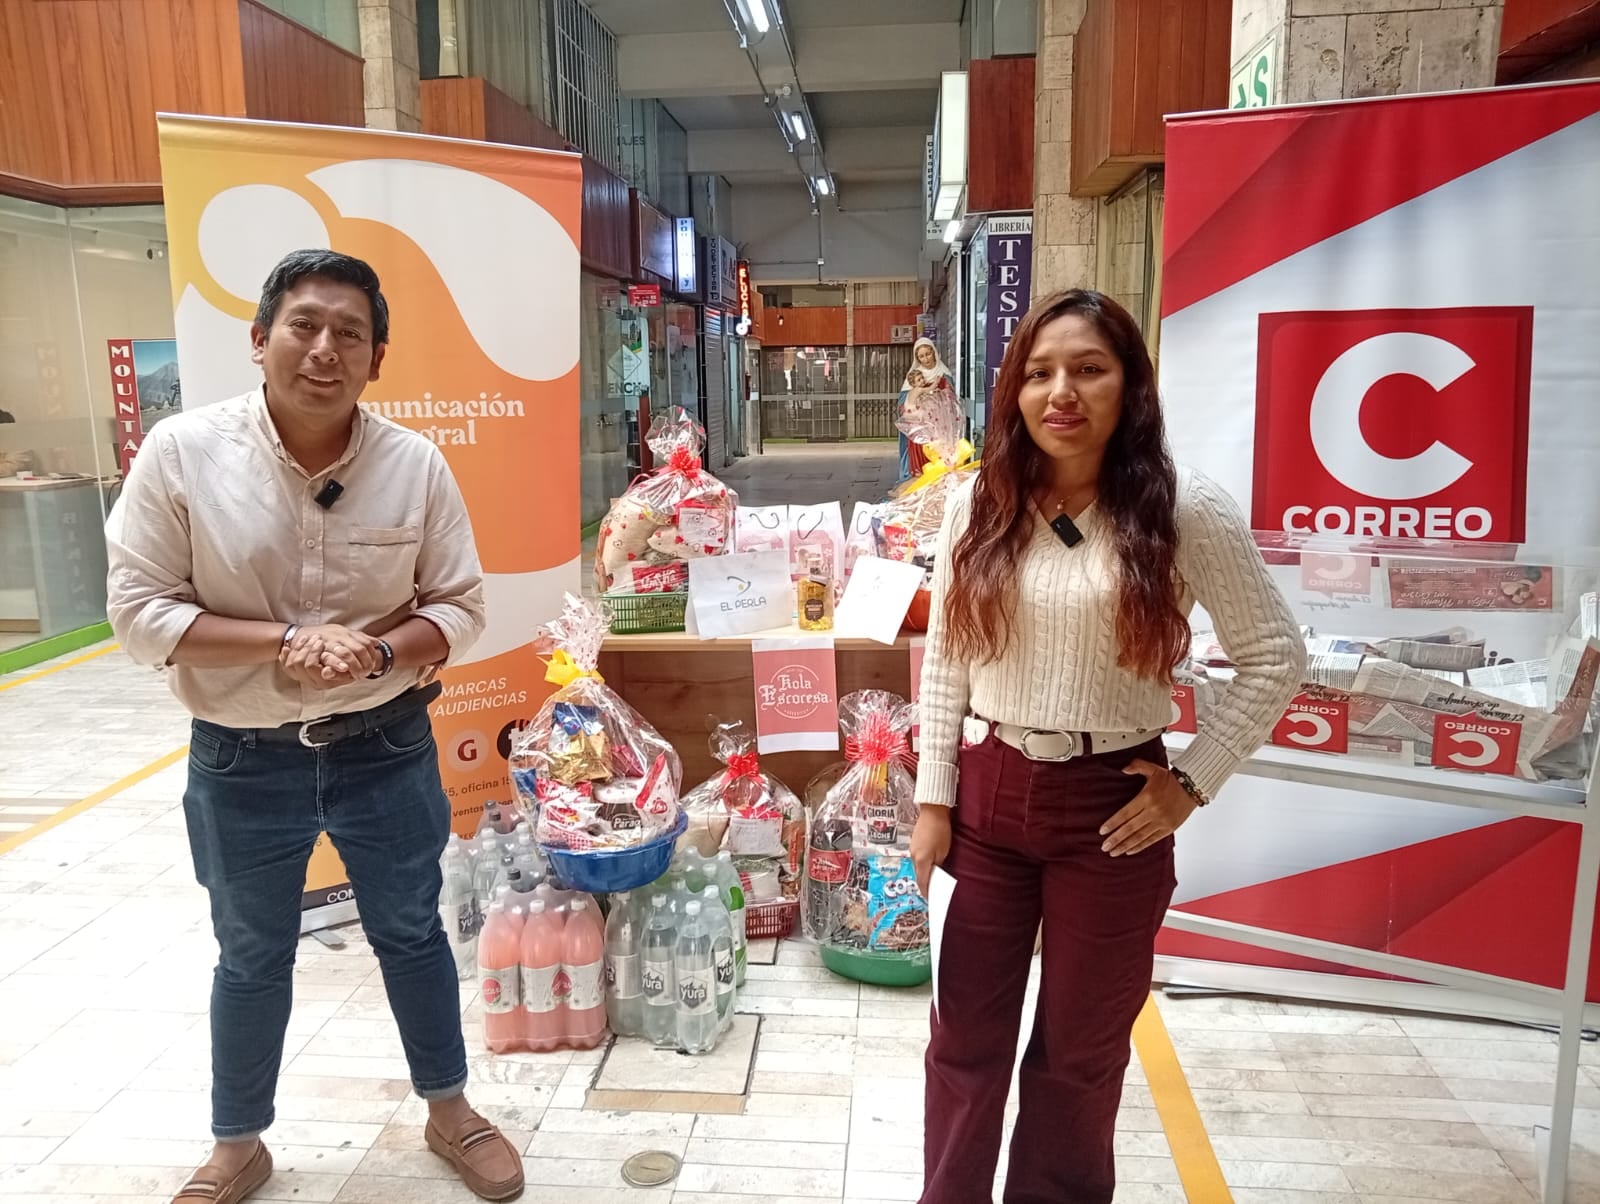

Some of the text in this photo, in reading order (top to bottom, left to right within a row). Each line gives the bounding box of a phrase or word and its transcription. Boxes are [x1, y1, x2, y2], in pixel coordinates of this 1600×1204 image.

[989, 219, 1031, 233] LIBRERÍA
[1310, 332, 1476, 500] C
[1282, 505, 1492, 539] CORREO
[720, 596, 767, 612] EL PERLA
[440, 677, 507, 699] MARCAS
[433, 690, 527, 718] AUDIENCIAS
[1290, 703, 1340, 716] CORRE
[1444, 721, 1511, 735] CORREO
[462, 781, 499, 795] oficina
[453, 805, 485, 818] ventas
[867, 807, 895, 819] GLORIA
[681, 985, 706, 1000] yura
